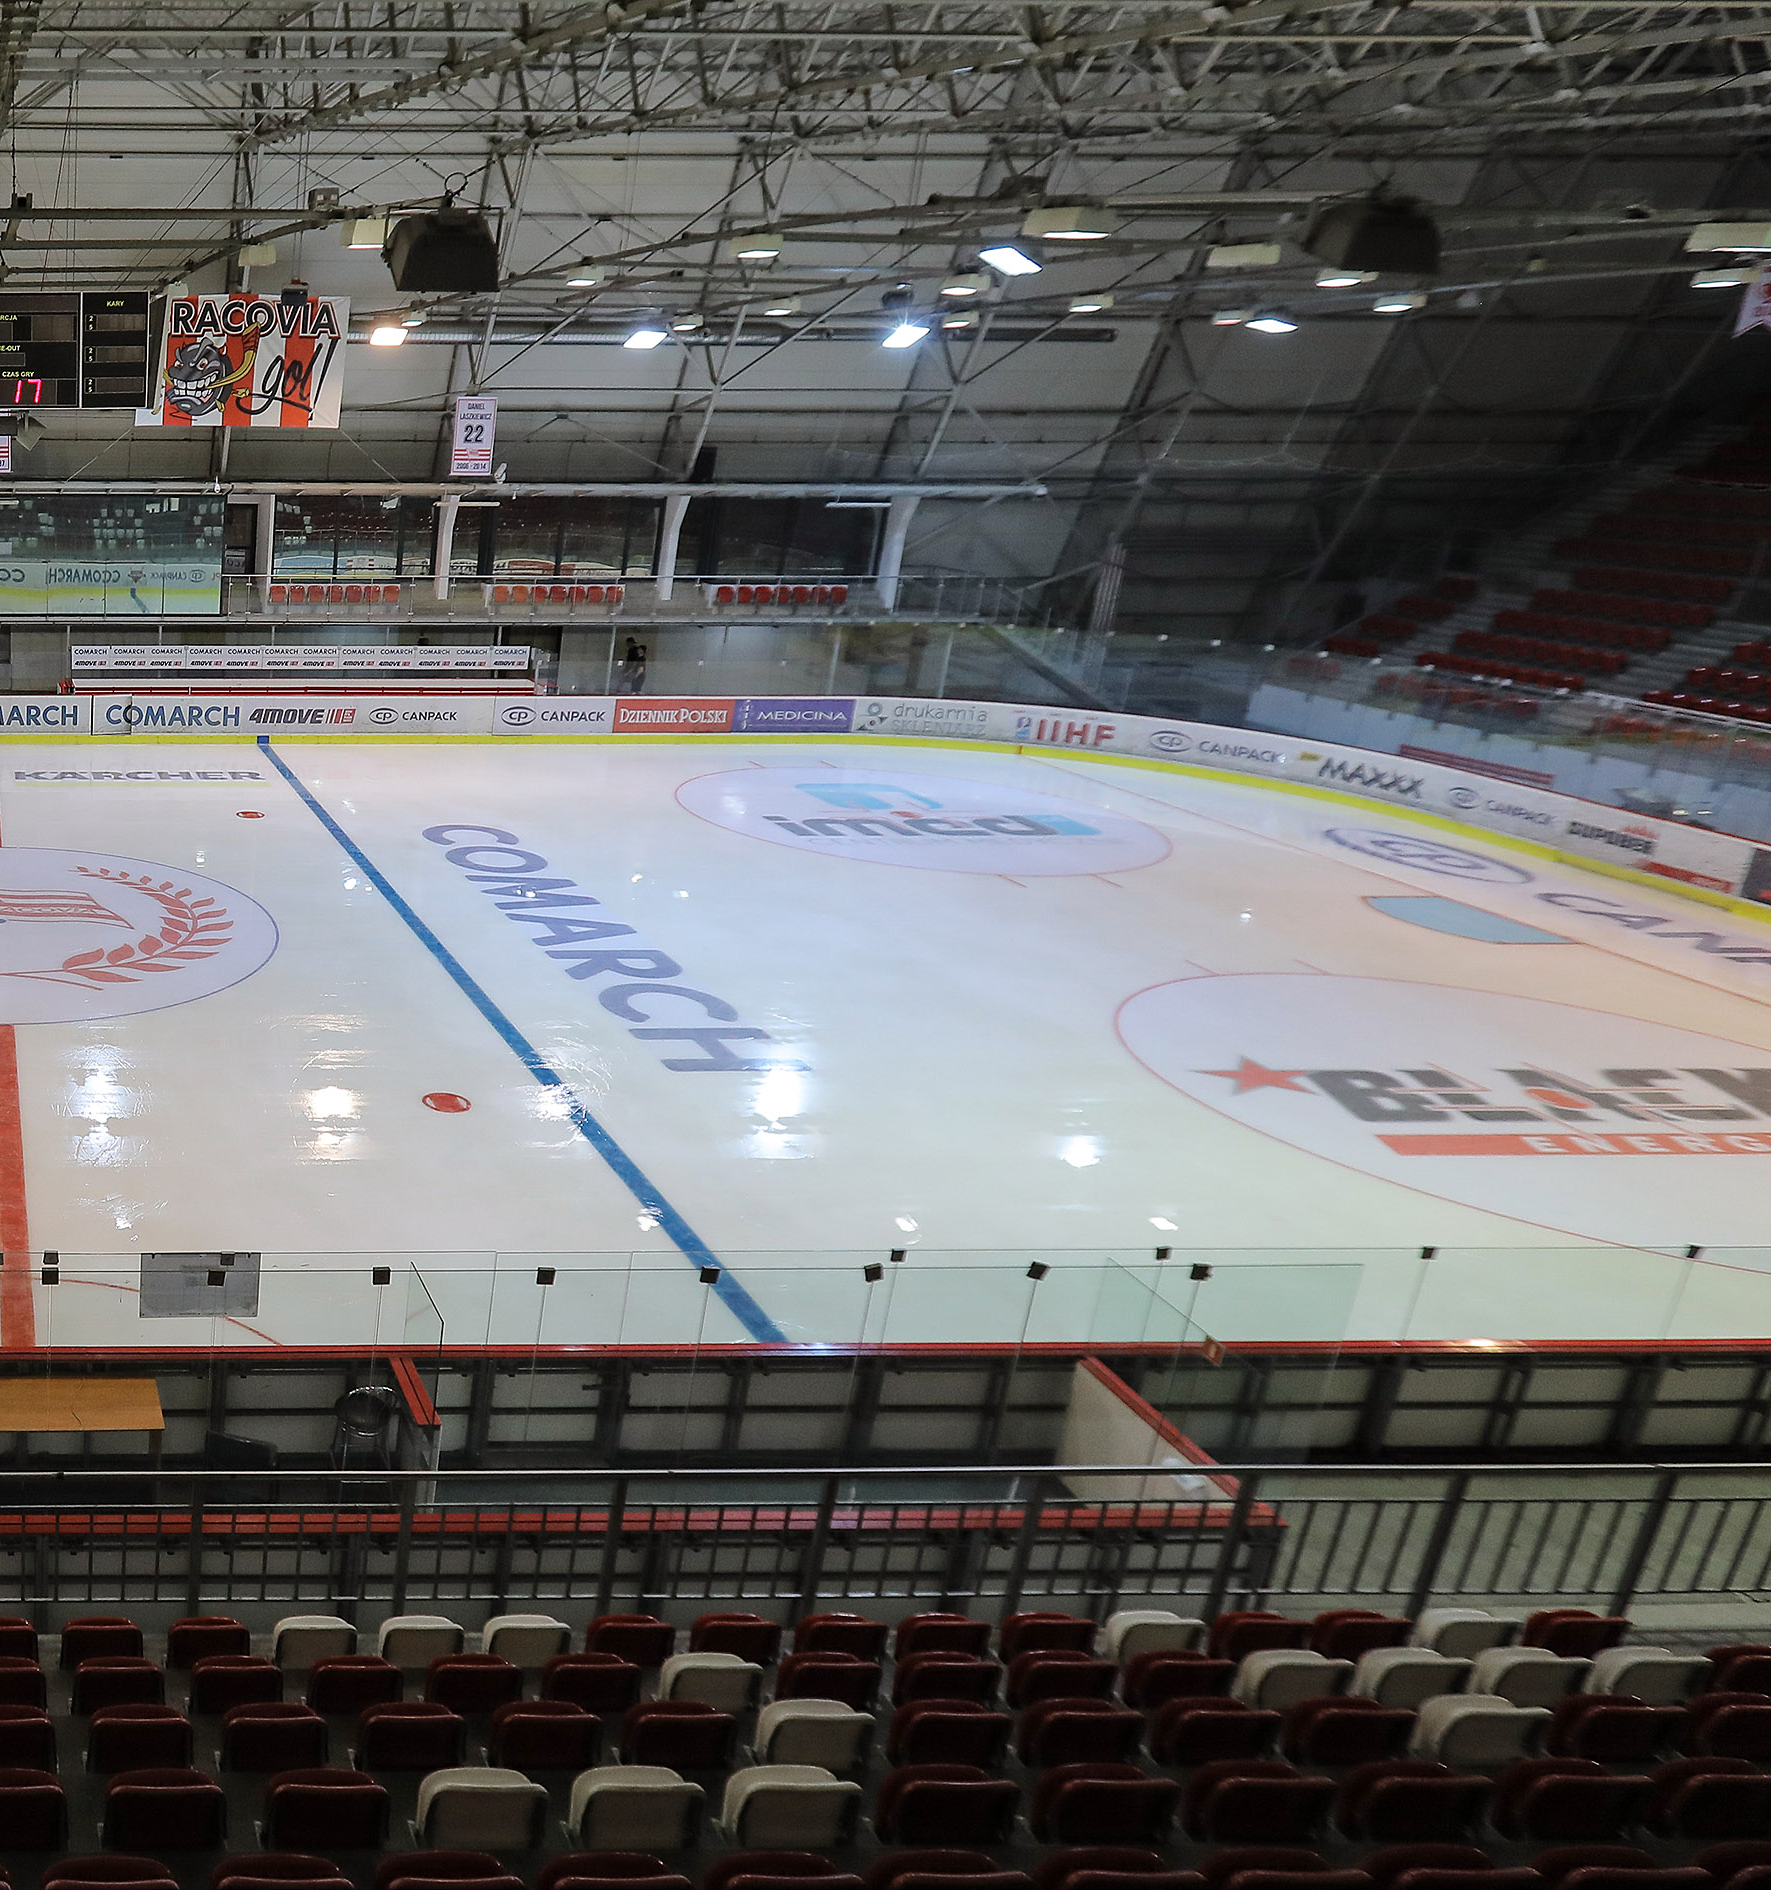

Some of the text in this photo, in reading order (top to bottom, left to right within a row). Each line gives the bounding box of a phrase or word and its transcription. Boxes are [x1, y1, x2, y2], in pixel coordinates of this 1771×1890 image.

[463, 425, 484, 443] 22
[106, 705, 241, 727] COMARCH
[249, 708, 325, 724] 4MOVE
[402, 710, 458, 721] CANPACK
[540, 711, 606, 722] CANPACK
[619, 708, 728, 723] DZIENNIK POLSKI
[757, 710, 848, 721] MEDICINA
[894, 703, 988, 722] drukarnia
[1036, 719, 1116, 746] IIHF
[1199, 741, 1285, 763] CANPACK
[1535, 892, 1771, 965] CAN
[422, 824, 813, 1072] COMARCH
